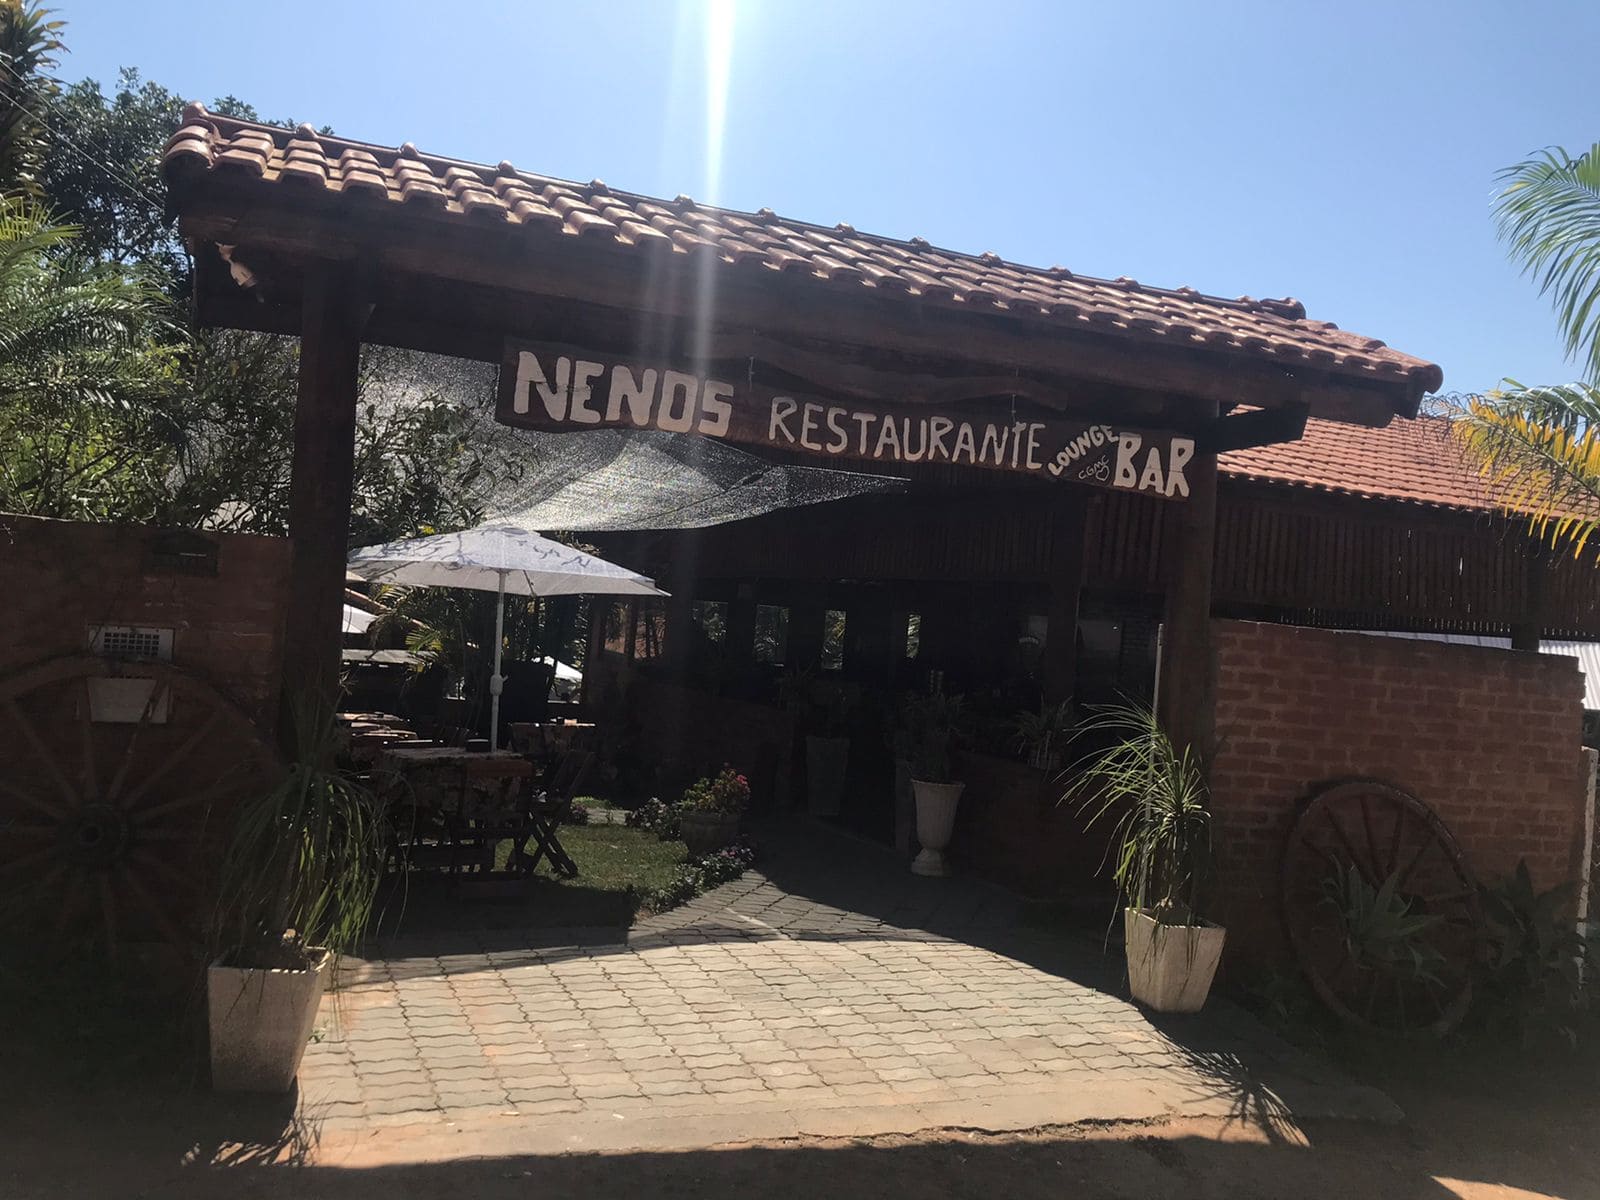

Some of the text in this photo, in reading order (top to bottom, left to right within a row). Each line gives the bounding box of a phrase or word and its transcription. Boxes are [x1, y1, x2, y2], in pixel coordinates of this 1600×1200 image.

[513, 351, 1195, 497] NENOS RESTAURANTE LOUNGE BAR
